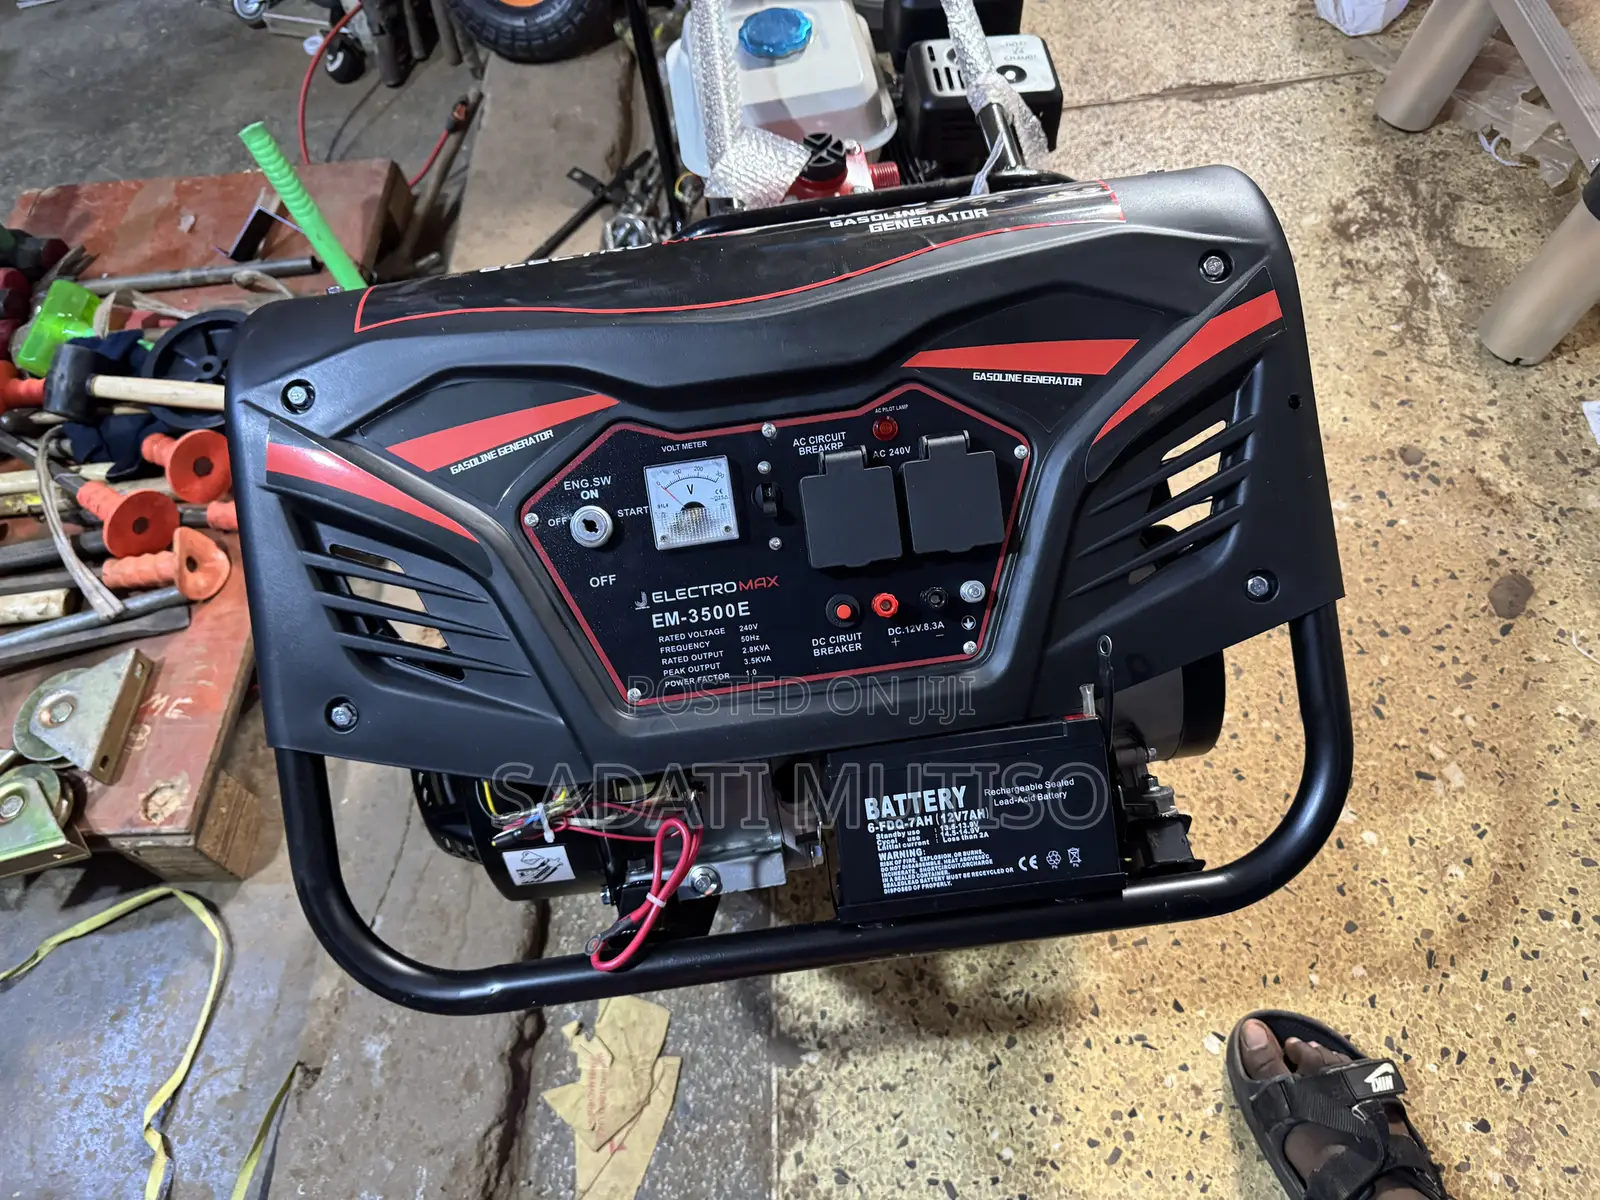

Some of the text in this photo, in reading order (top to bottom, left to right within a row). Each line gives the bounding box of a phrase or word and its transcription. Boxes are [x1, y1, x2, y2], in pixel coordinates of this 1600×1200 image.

[830, 207, 928, 228] GASOLINE
[868, 207, 989, 233] GENERATOR
[973, 372, 1082, 386] GASOLINE GENERATOR
[661, 440, 708, 452] VOLT METER
[793, 431, 846, 447] AC CIRCUIT
[450, 429, 554, 475] GASOLINE GENERATOR
[873, 446, 910, 458] AC 240V
[564, 476, 612, 490] ENG.SW
[686, 484, 694, 494] V
[580, 488, 600, 500] ON
[617, 506, 649, 518] START
[548, 516, 568, 527] OFF
[590, 574, 617, 588] OFF
[652, 575, 779, 604] ELECTROMAX
[652, 601, 750, 628] EM-3500E
[658, 623, 758, 643] RATED VOLTAGE 240V
[888, 620, 944, 636] DC.12V.8.3A
[660, 634, 760, 654] FREQUENCY 50Hz
[812, 632, 862, 646] DC CIRUIT
[662, 644, 770, 666] RATED OUTPUT 2.8KVA
[813, 642, 862, 656] BREAKER
[663, 655, 772, 676] PEAK OUTPUT 3.5KVA
[664, 678, 694, 688] POWER
[697, 672, 730, 684] FACTOR
[984, 778, 1074, 796] Rechargeable Sealed
[864, 786, 967, 820] BATTERY
[994, 791, 1068, 806] Lead-Acid Battery
[867, 806, 989, 833] 6-FDQ-7AH (12V7AH)
[876, 830, 906, 840] Standby
[902, 839, 930, 848] current
[878, 848, 926, 861] WARNING:
